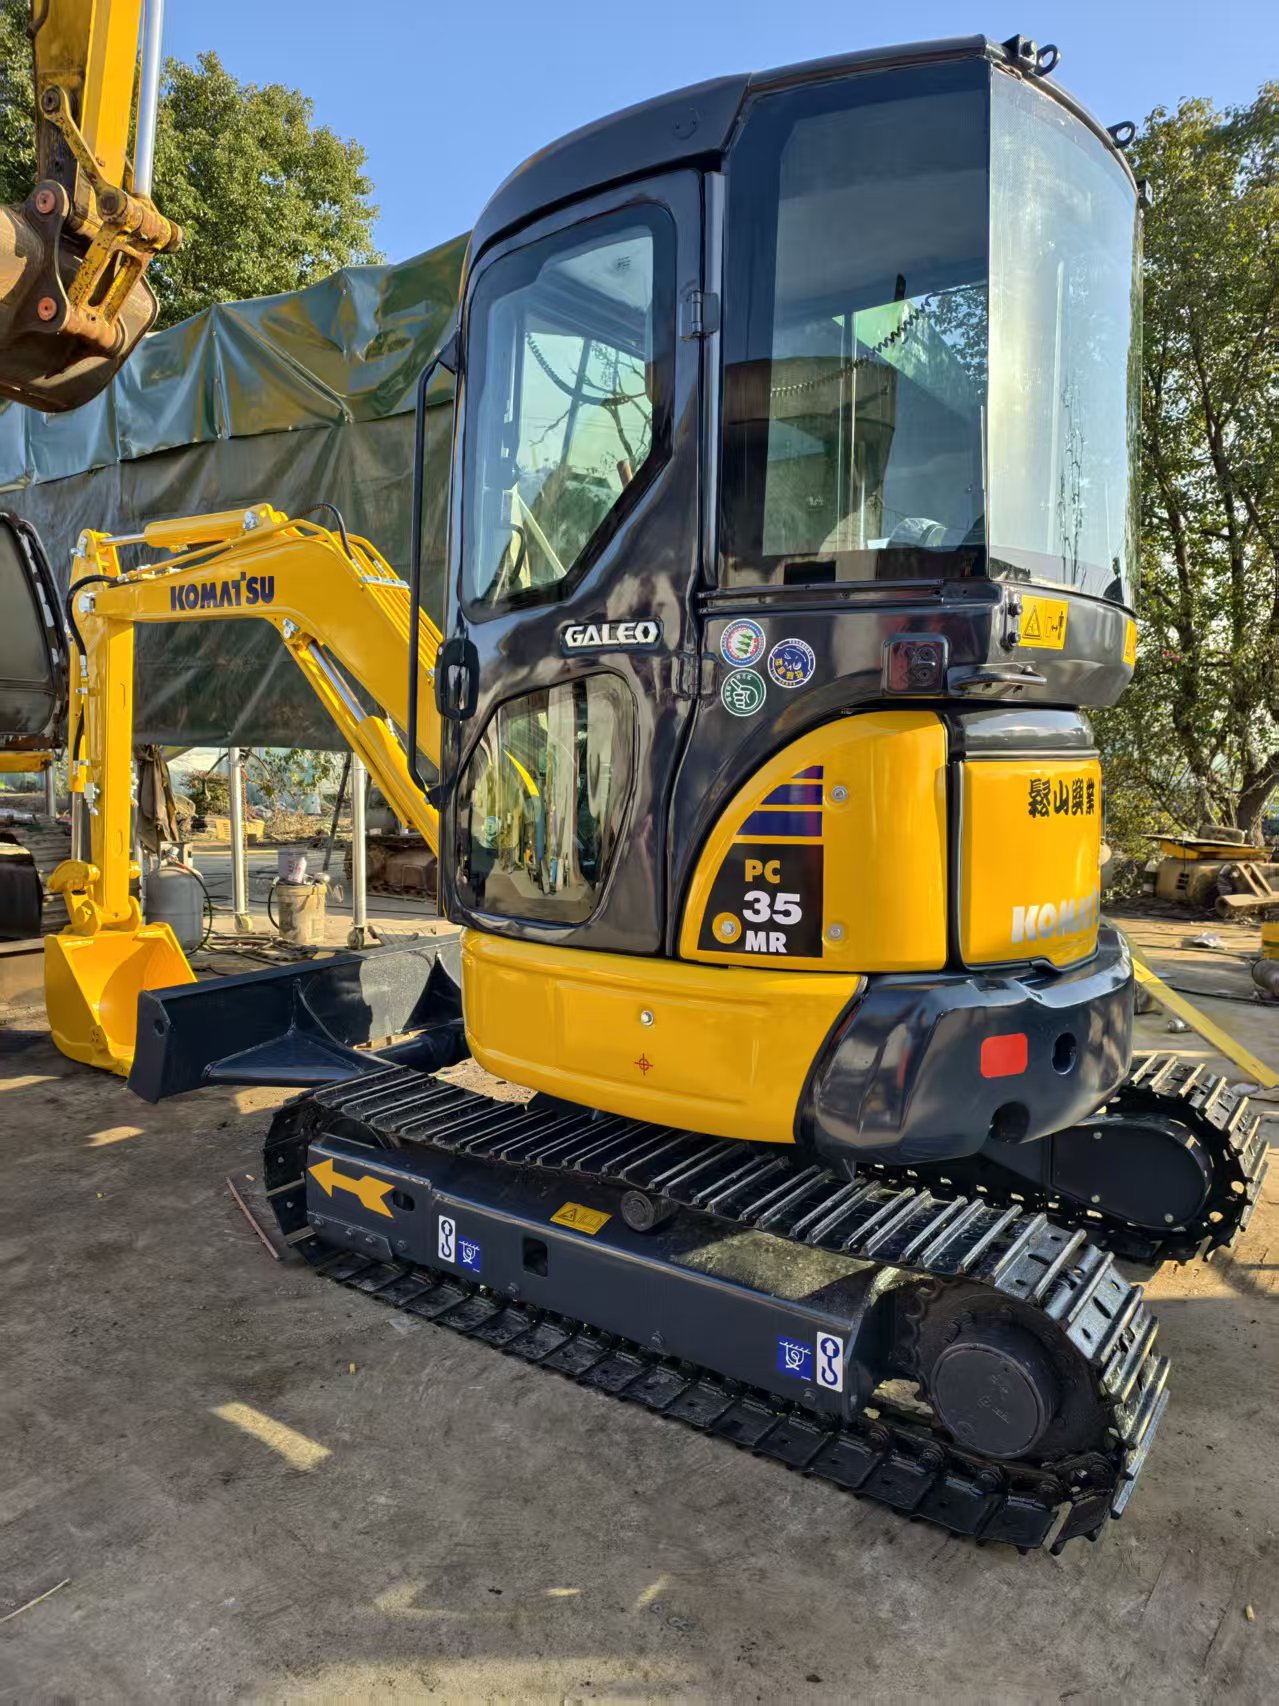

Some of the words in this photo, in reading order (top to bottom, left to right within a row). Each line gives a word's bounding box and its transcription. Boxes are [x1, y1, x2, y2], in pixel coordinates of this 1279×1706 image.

[170, 572, 274, 611] KOMATSU
[565, 621, 658, 647] GALEO
[745, 859, 780, 884] PC
[742, 890, 802, 925] 35
[1011, 884, 1099, 943] KOMAT
[745, 930, 787, 953] MR
